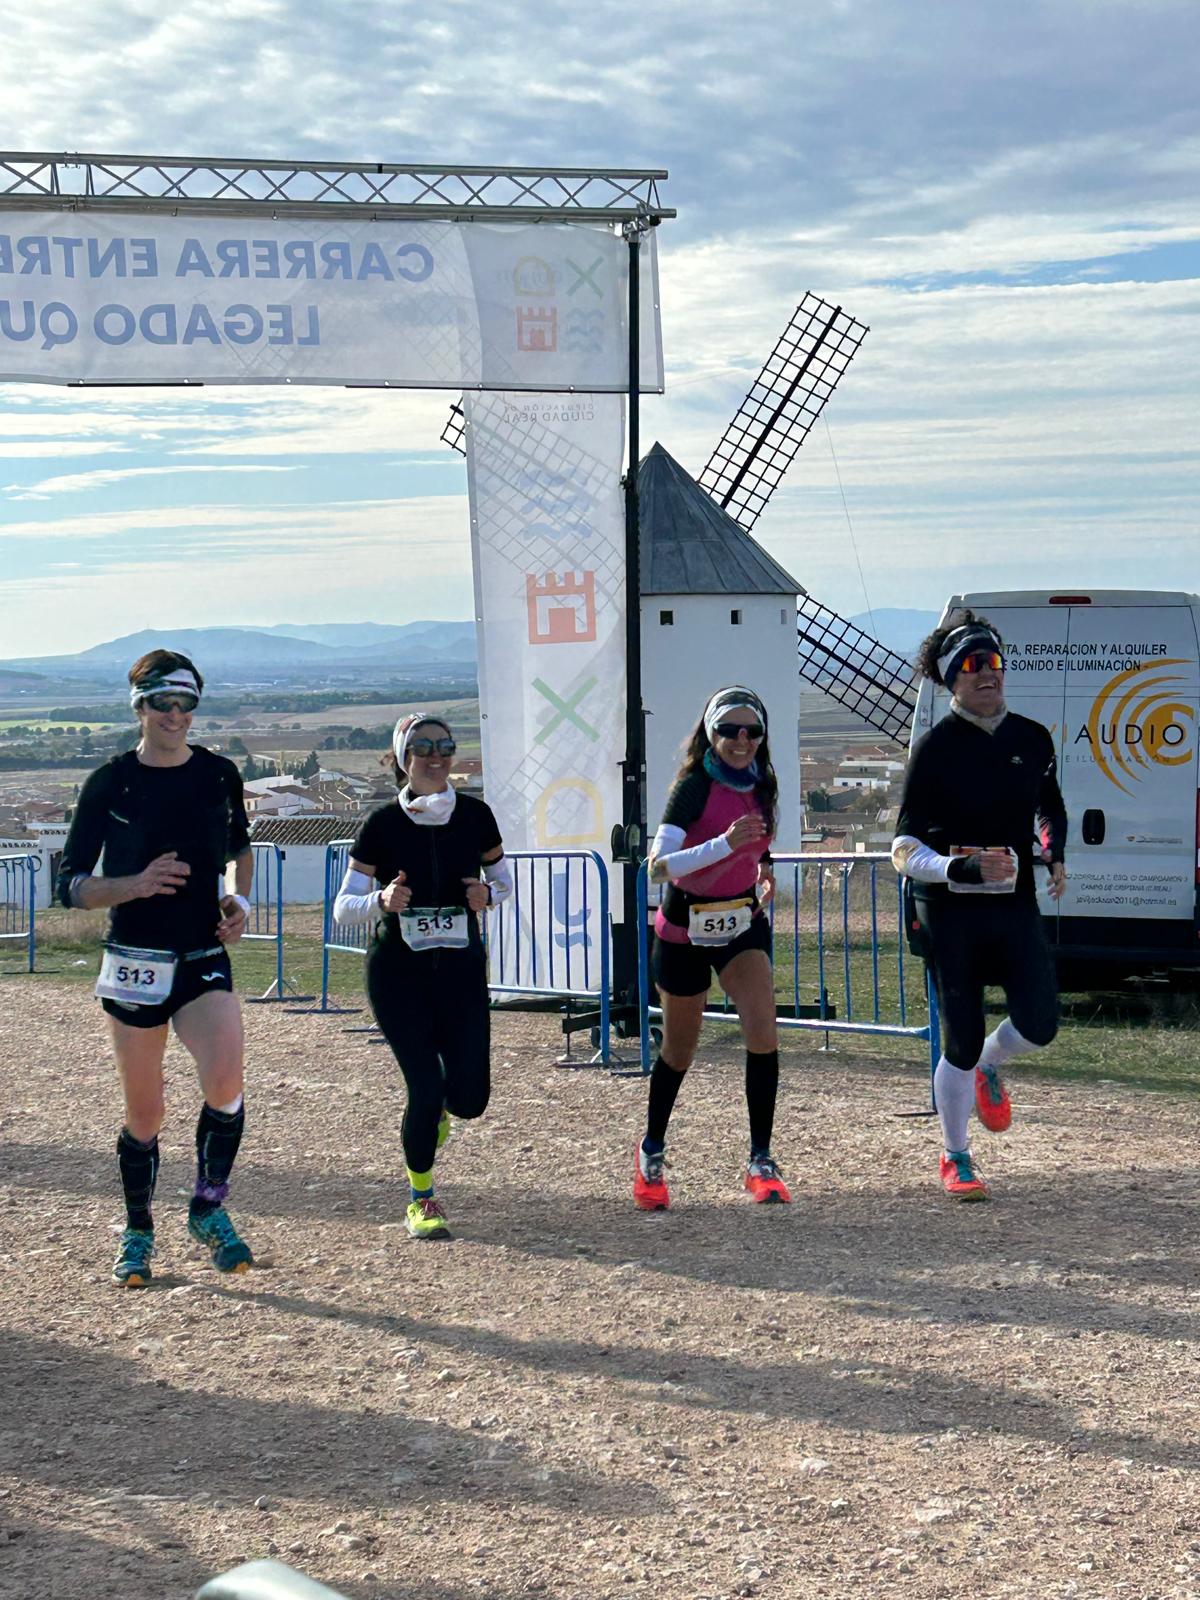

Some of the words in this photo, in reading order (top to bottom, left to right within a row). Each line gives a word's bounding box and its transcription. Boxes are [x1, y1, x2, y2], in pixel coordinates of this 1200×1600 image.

[1100, 643, 1108, 655] Y
[1109, 643, 1168, 656] ALQUILER
[1010, 659, 1054, 672] SONIDO
[1056, 659, 1065, 671] E
[1066, 657, 1141, 672] ILUMINACIÓN
[416, 916, 454, 932] 513
[703, 916, 738, 932] 513
[116, 965, 156, 986] 513
